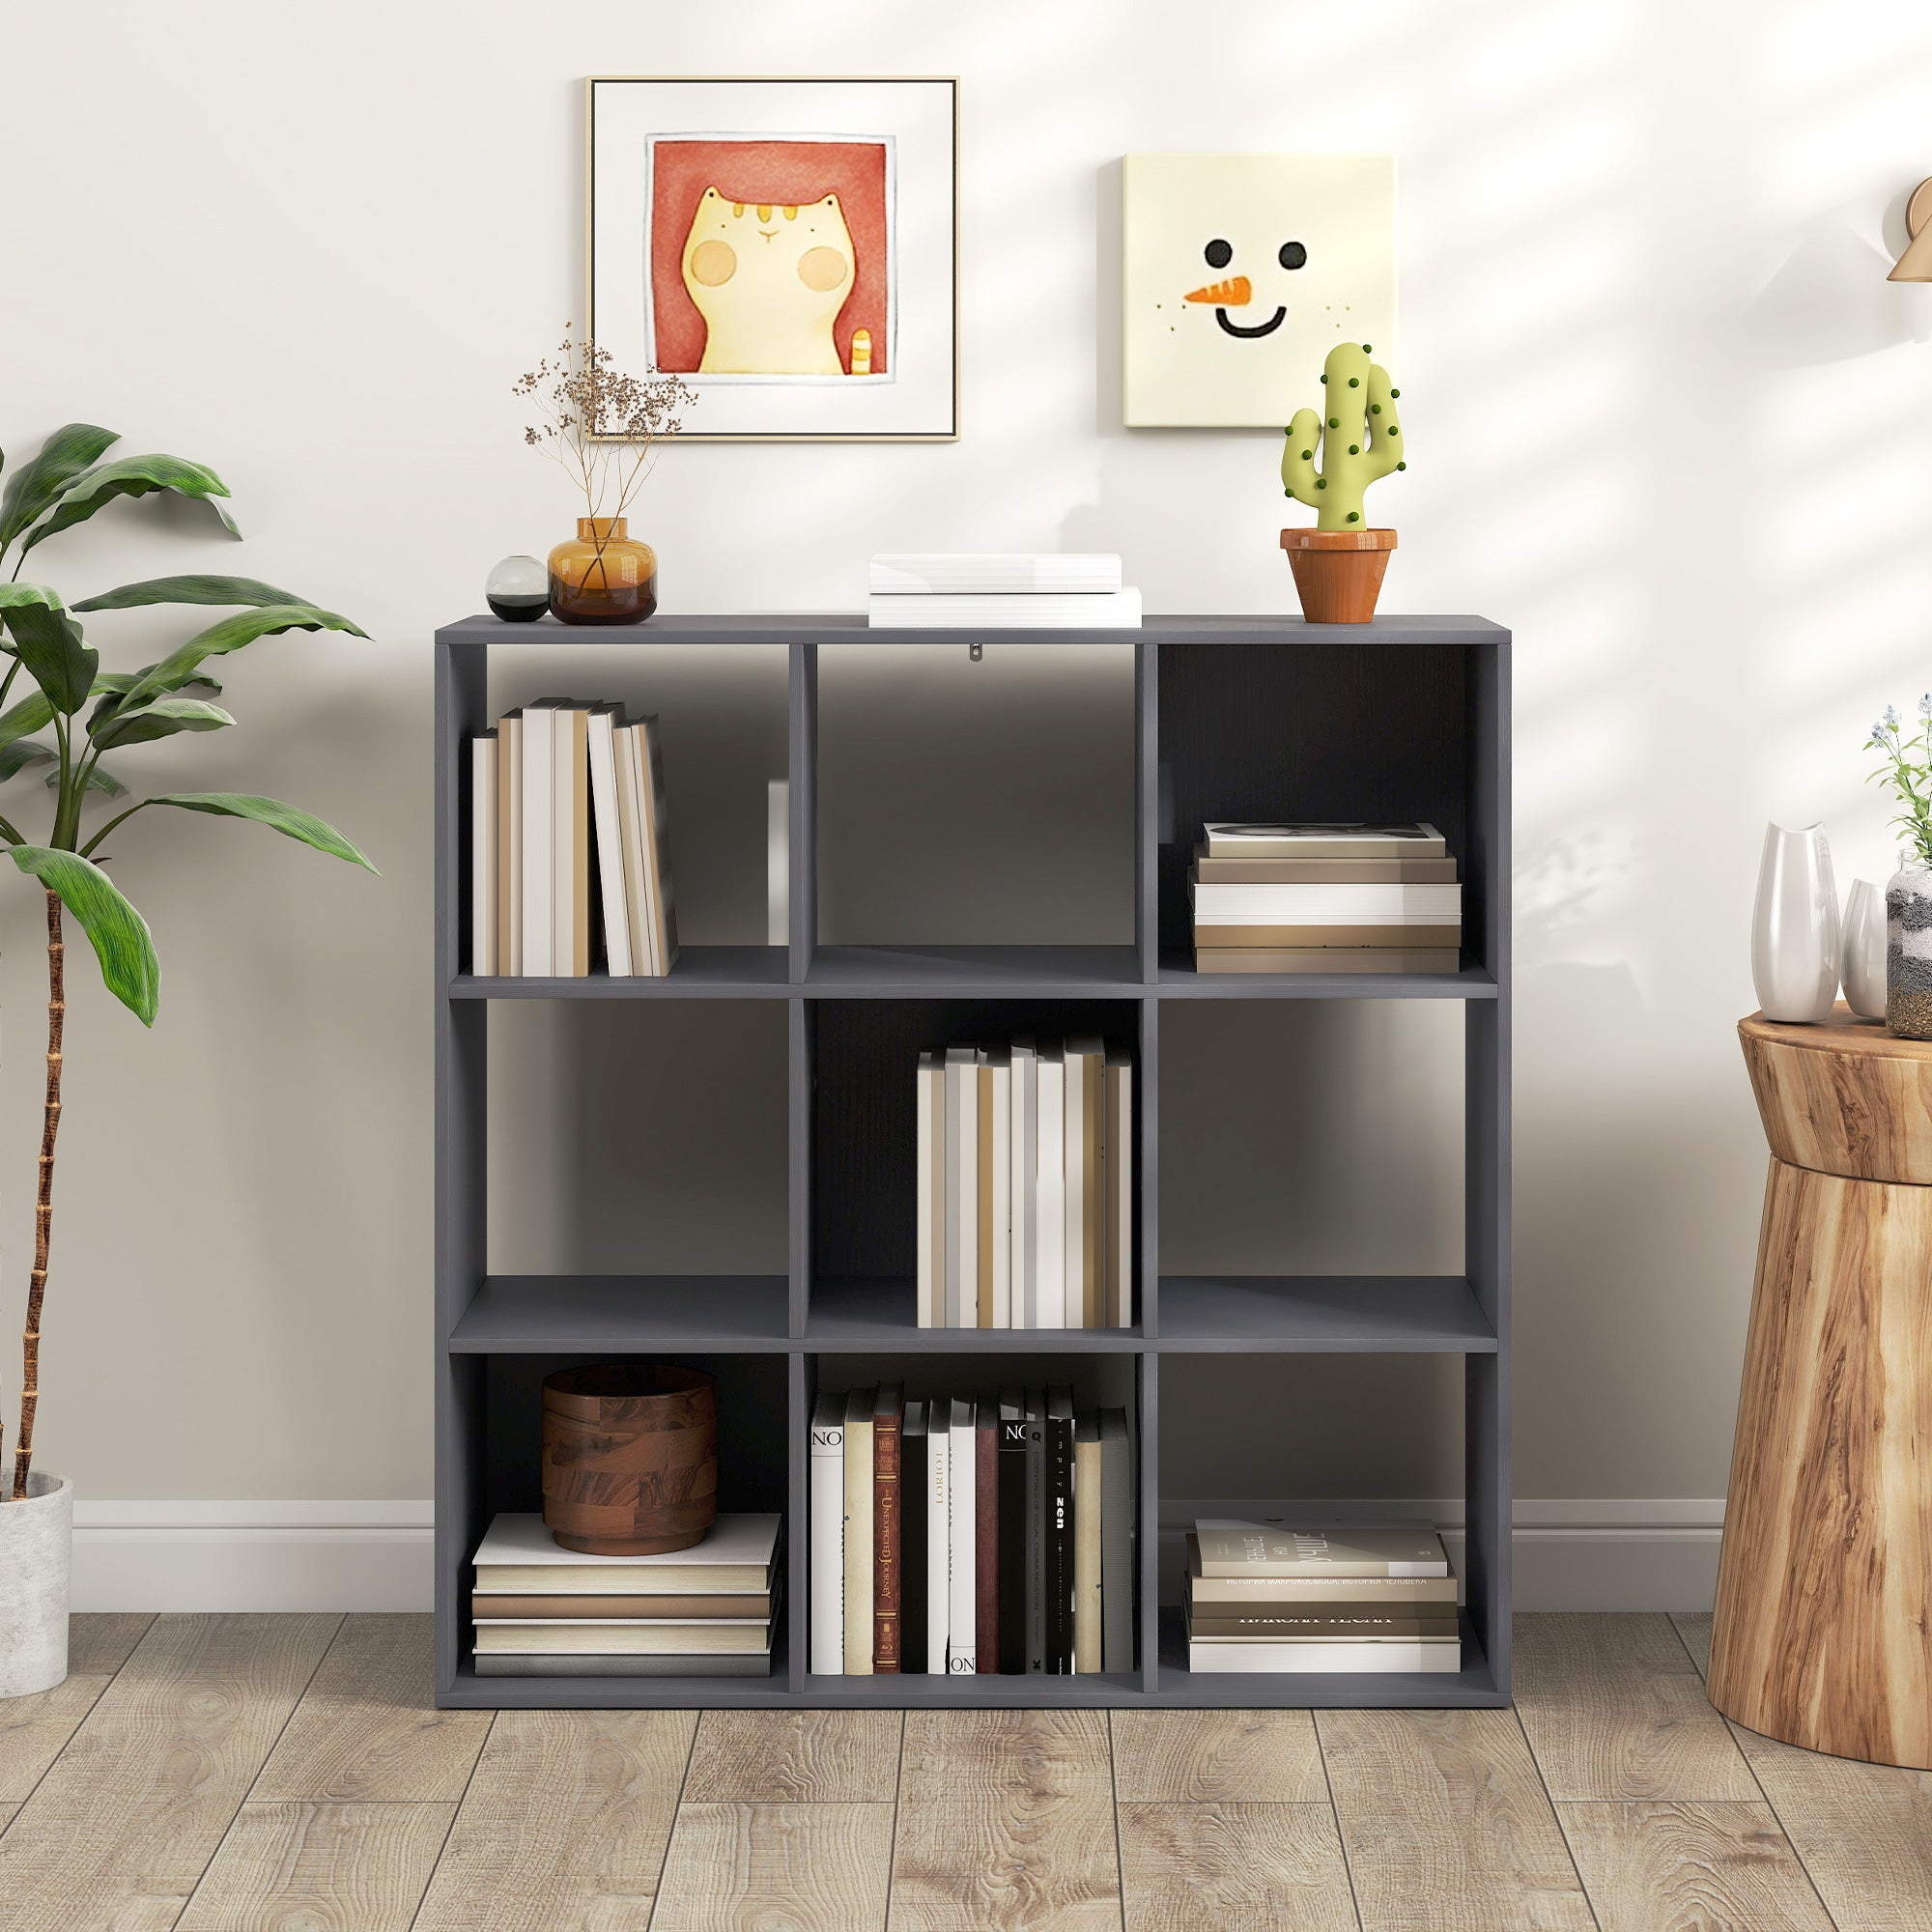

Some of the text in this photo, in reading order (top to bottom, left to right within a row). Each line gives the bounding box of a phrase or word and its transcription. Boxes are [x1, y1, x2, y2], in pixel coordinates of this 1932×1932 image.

[811, 1431, 842, 1445] NO
[881, 1496, 893, 1557] UNEXPECTED
[1056, 1496, 1065, 1529] zen
[878, 1557, 893, 1599] JOURNEY
